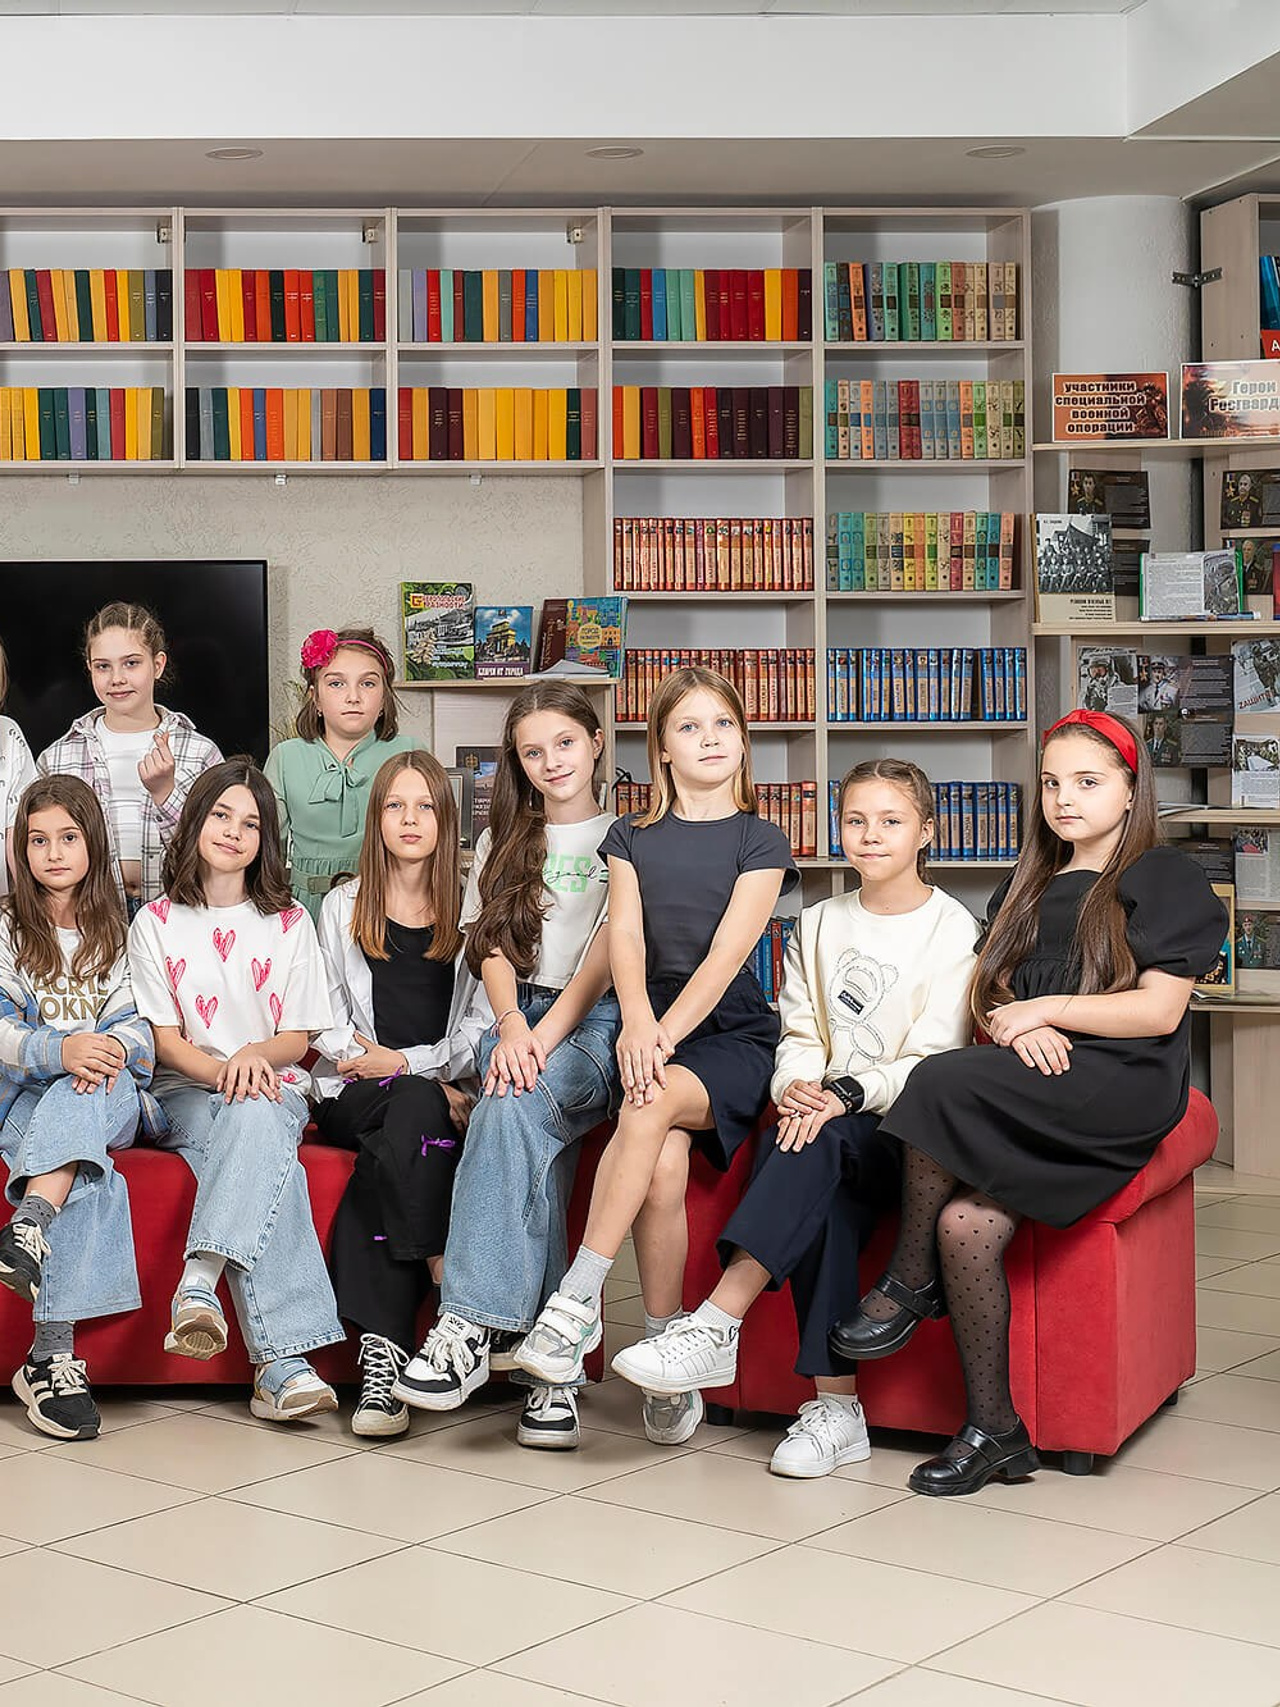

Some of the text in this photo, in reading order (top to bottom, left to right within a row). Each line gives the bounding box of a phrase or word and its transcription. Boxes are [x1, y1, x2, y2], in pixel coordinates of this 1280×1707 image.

[1064, 382, 1135, 393] участники
[1232, 381, 1276, 394] Герои
[1055, 393, 1146, 407] специальной
[1071, 407, 1129, 419] военной
[1067, 422, 1133, 433] операции
